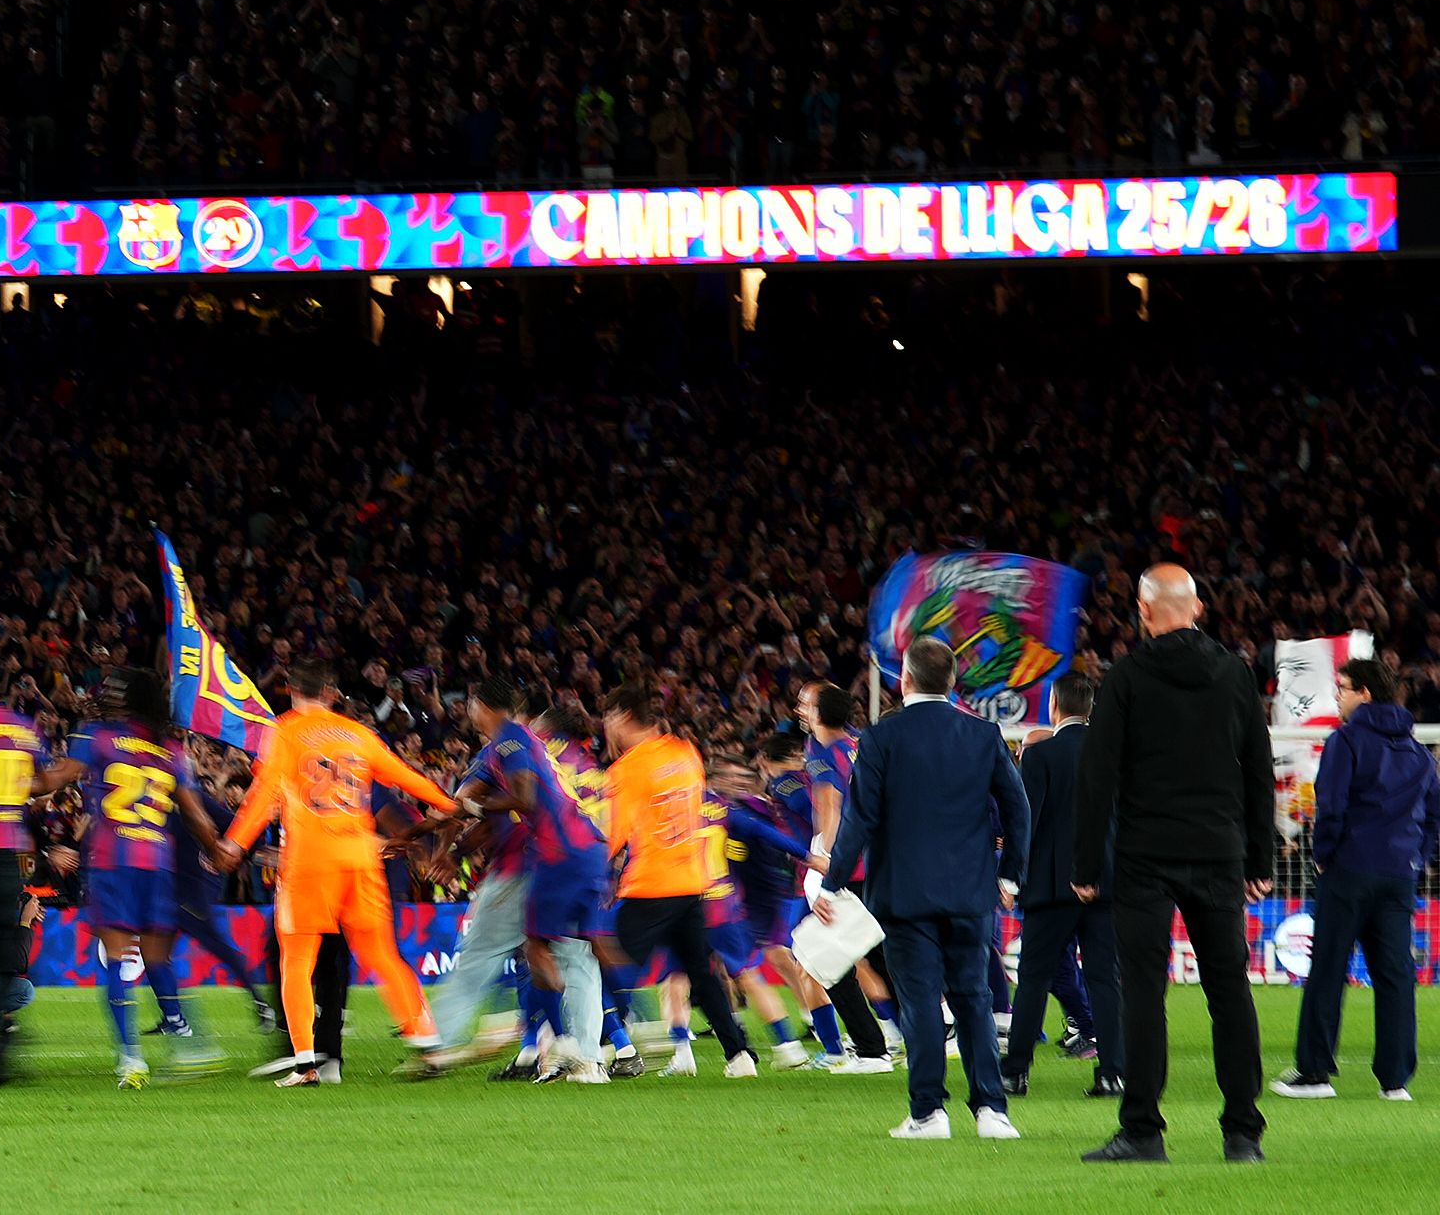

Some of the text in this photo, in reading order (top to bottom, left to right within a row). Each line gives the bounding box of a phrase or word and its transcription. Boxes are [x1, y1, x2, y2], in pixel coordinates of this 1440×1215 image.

[530, 179, 1287, 260] CAMPIONS DE LLIGA 25/26
